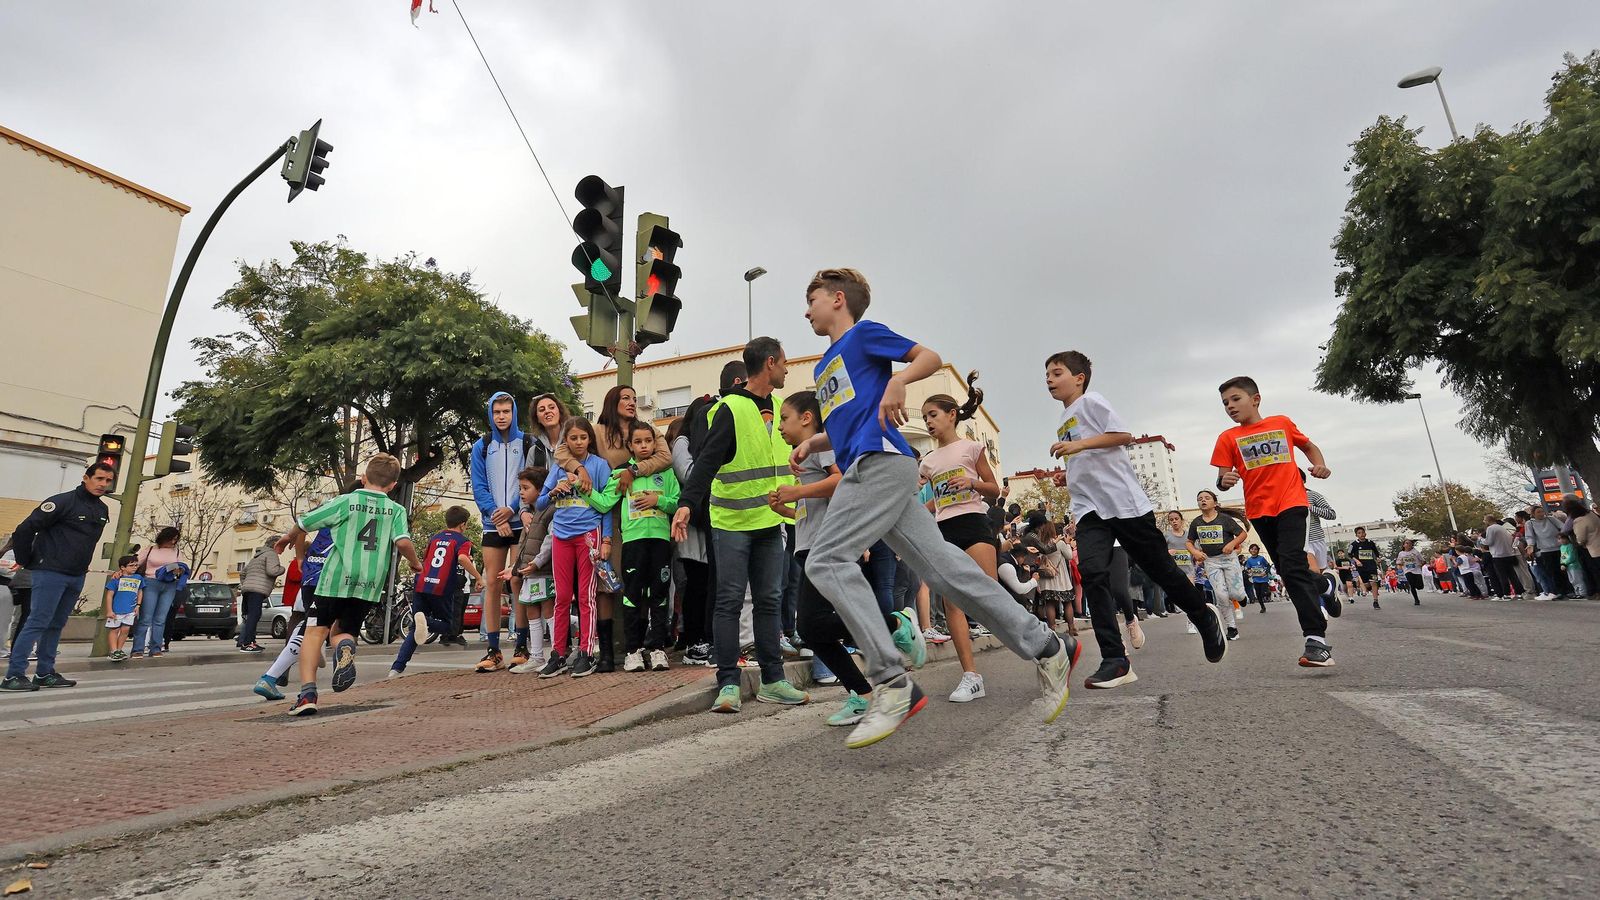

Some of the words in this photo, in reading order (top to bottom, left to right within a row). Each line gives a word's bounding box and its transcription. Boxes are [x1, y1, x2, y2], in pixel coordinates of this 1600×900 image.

[1249, 440, 1281, 456] 107
[349, 504, 393, 516] GONZALO
[357, 518, 378, 551] 4
[1201, 531, 1219, 539] 203
[431, 547, 447, 568] 8
